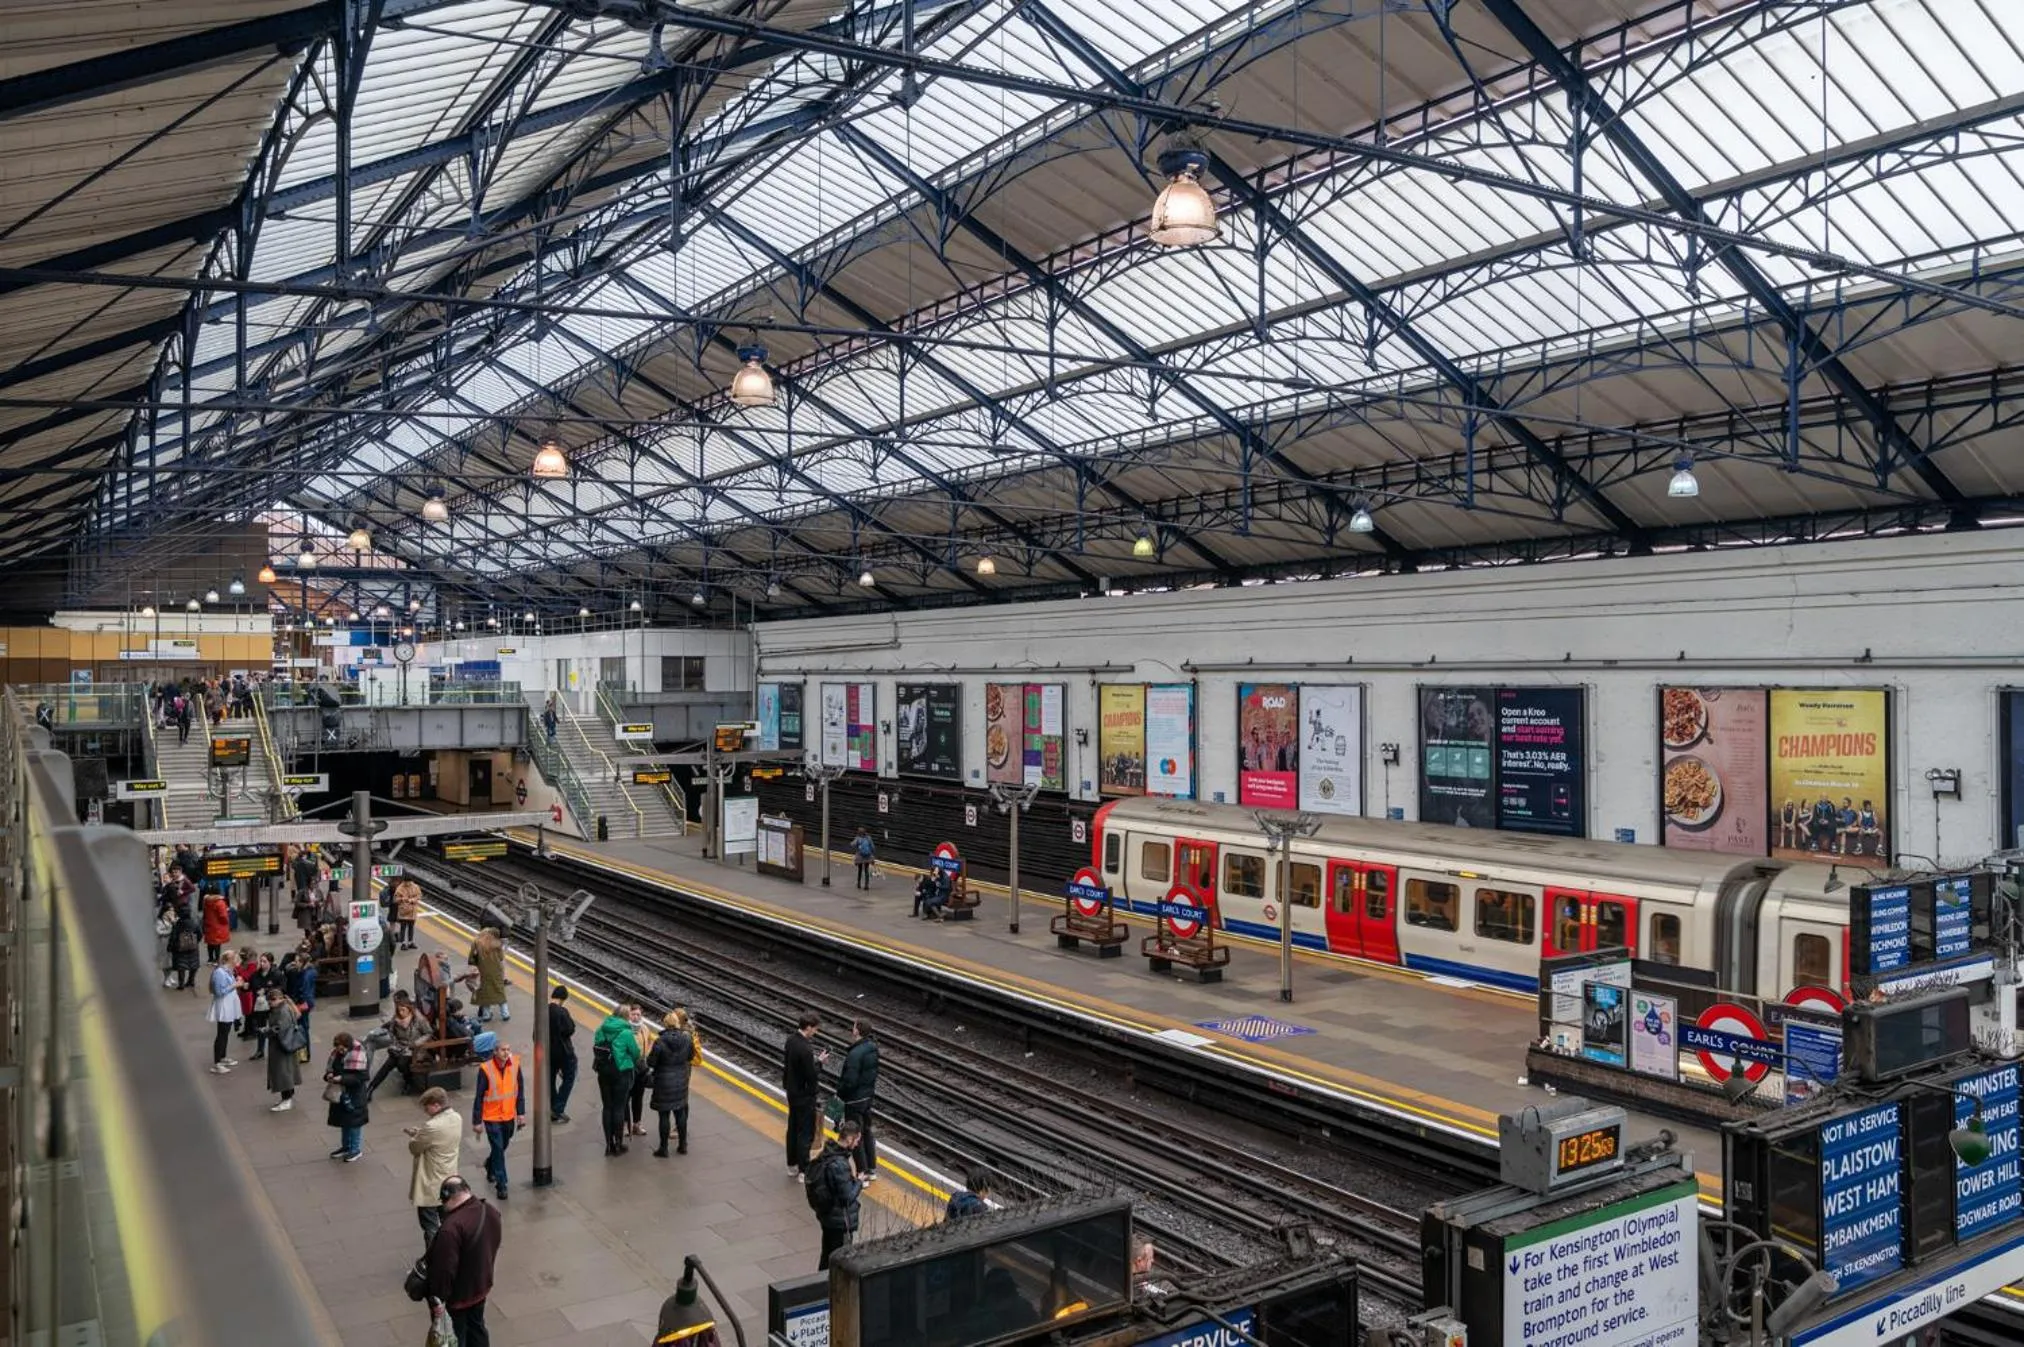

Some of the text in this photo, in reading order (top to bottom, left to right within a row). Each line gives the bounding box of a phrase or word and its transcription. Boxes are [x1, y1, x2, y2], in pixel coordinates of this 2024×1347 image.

[1262, 696, 1285, 709] ROAD
[1501, 707, 1521, 717] Open
[1528, 707, 1546, 716] Kroo
[1501, 717, 1560, 726] current account
[1501, 725, 1516, 733] and
[1501, 750, 1524, 759] That's
[1550, 752, 1567, 761] AER
[1778, 733, 1877, 758] CHAMPIONS
[1085, 888, 1104, 898] COURT
[1162, 904, 1202, 919] EARL'S COURT
[1871, 921, 1908, 935] WIMBLEDON
[1871, 936, 1908, 952] RICHMOND
[1687, 1031, 1777, 1060] EARL'S COURT
[2001, 1099, 2019, 1118] EAST
[1822, 1106, 1898, 1144] NOT IN SERVICE
[1822, 1138, 1897, 1184] PLAISTOW
[1957, 1160, 2020, 1200] TOWER HILL
[1823, 1172, 1899, 1219] WEST HAM
[1957, 1191, 2022, 1229] EDGWARE ROAD
[1524, 1204, 1679, 1270] For Kensington (Olympia)
[1824, 1207, 1899, 1252] EMBANKMENT
[1524, 1228, 1681, 1292] take the first Wimbledon
[1524, 1250, 1680, 1316] train and change at West
[1524, 1288, 1635, 1339] Brompton for the
[1603, 1304, 1649, 1333] service.
[1889, 1282, 1966, 1331] Piccadilly line
[800, 1315, 826, 1326] Piccad
[1656, 1327, 1685, 1345] operate
